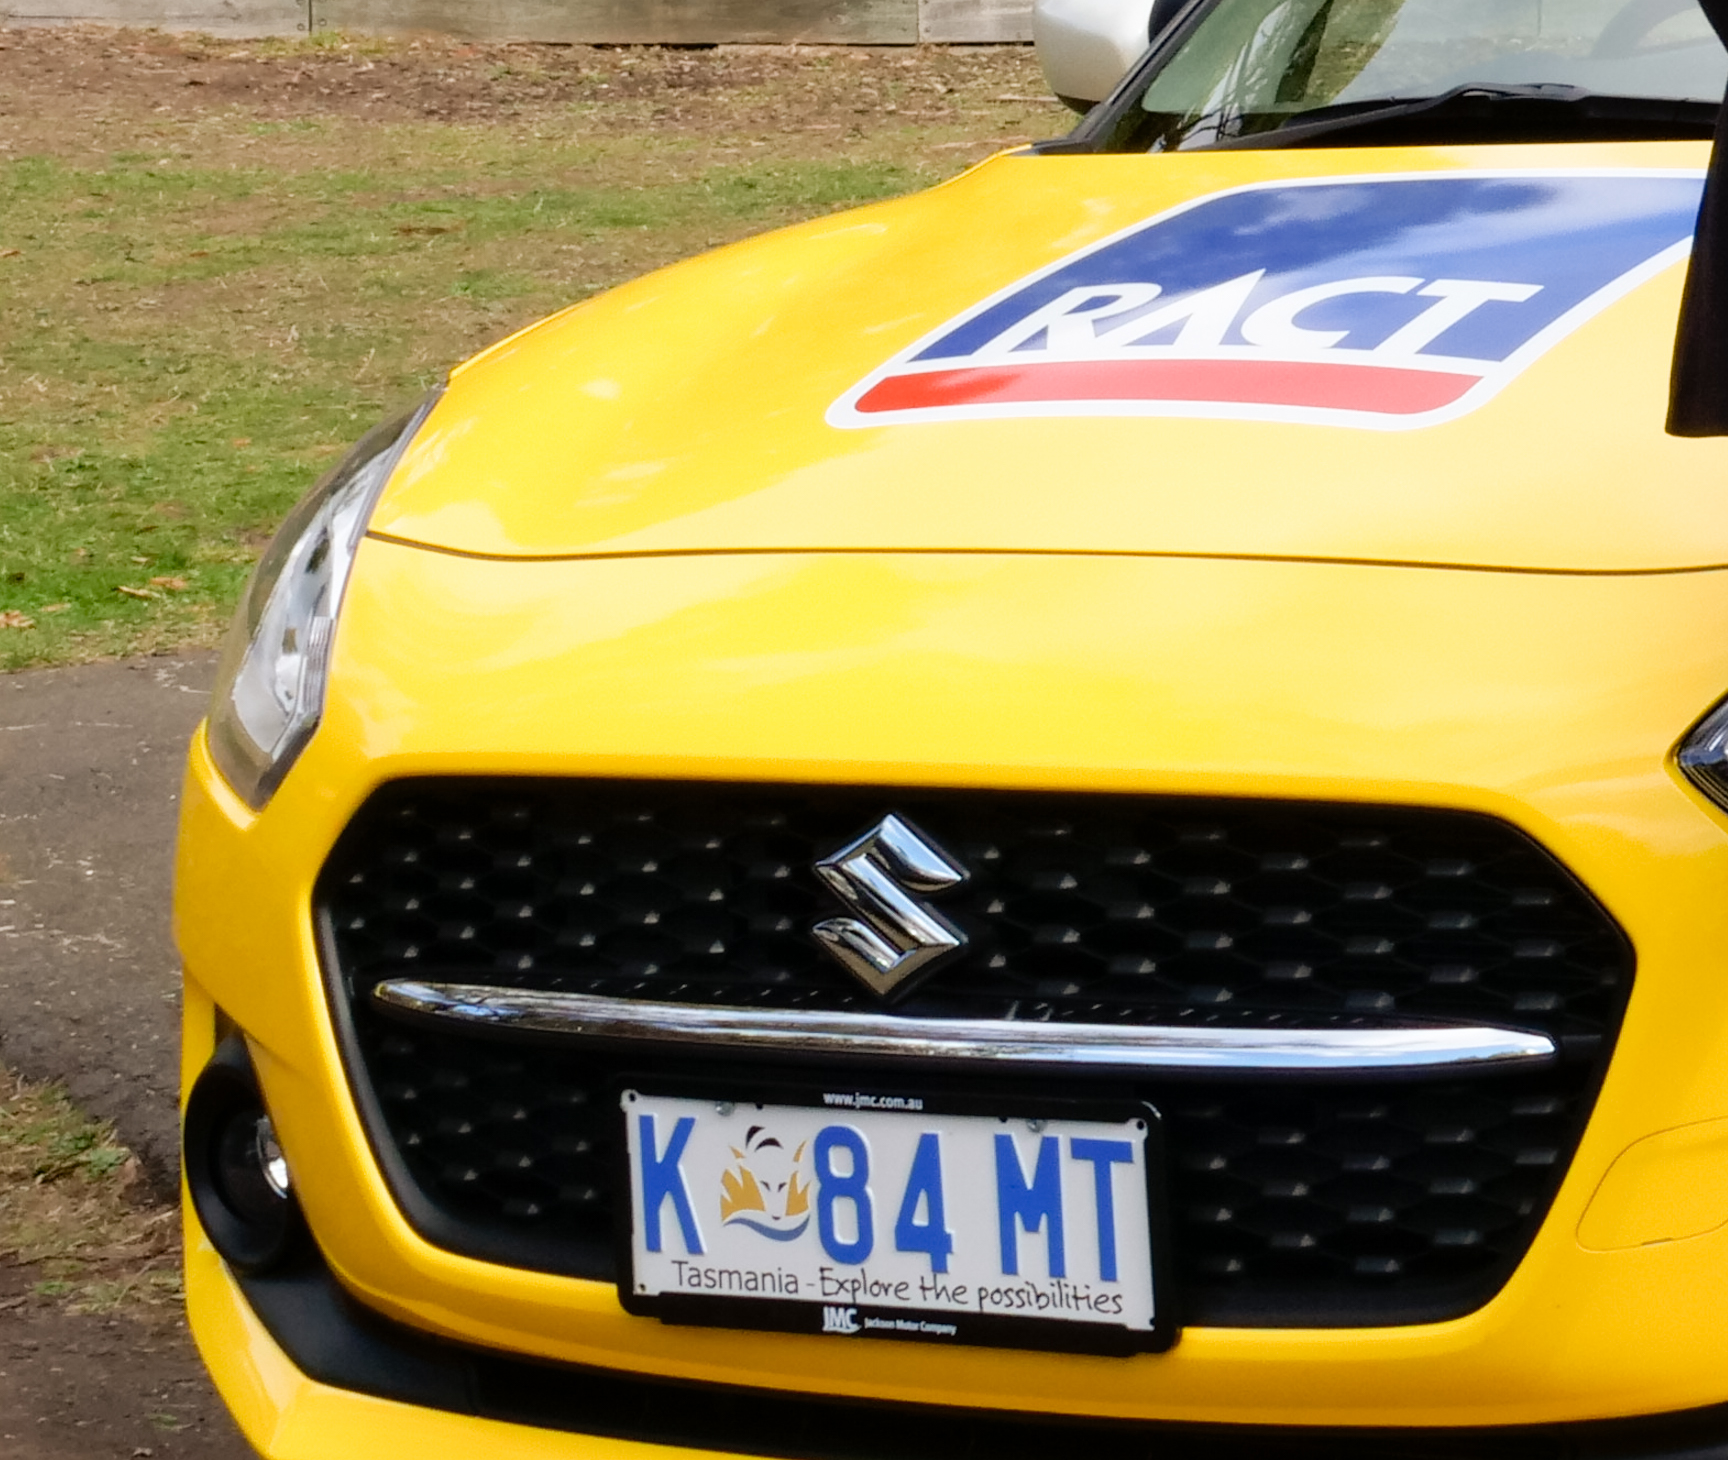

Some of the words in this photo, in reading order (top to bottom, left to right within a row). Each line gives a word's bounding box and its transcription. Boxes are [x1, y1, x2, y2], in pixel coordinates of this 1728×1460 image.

[970, 268, 1545, 357] RACT
[822, 1091, 924, 1111] www.jmc.com.au
[638, 1114, 706, 1255] K
[813, 1125, 954, 1274] 84
[994, 1133, 1135, 1282] MT
[671, 1260, 799, 1295] Tasmania
[819, 1266, 911, 1304] Explore
[920, 1274, 969, 1305] the
[978, 1281, 1124, 1315] possibilities
[822, 1305, 861, 1334] JMC
[920, 1320, 957, 1337] Company
